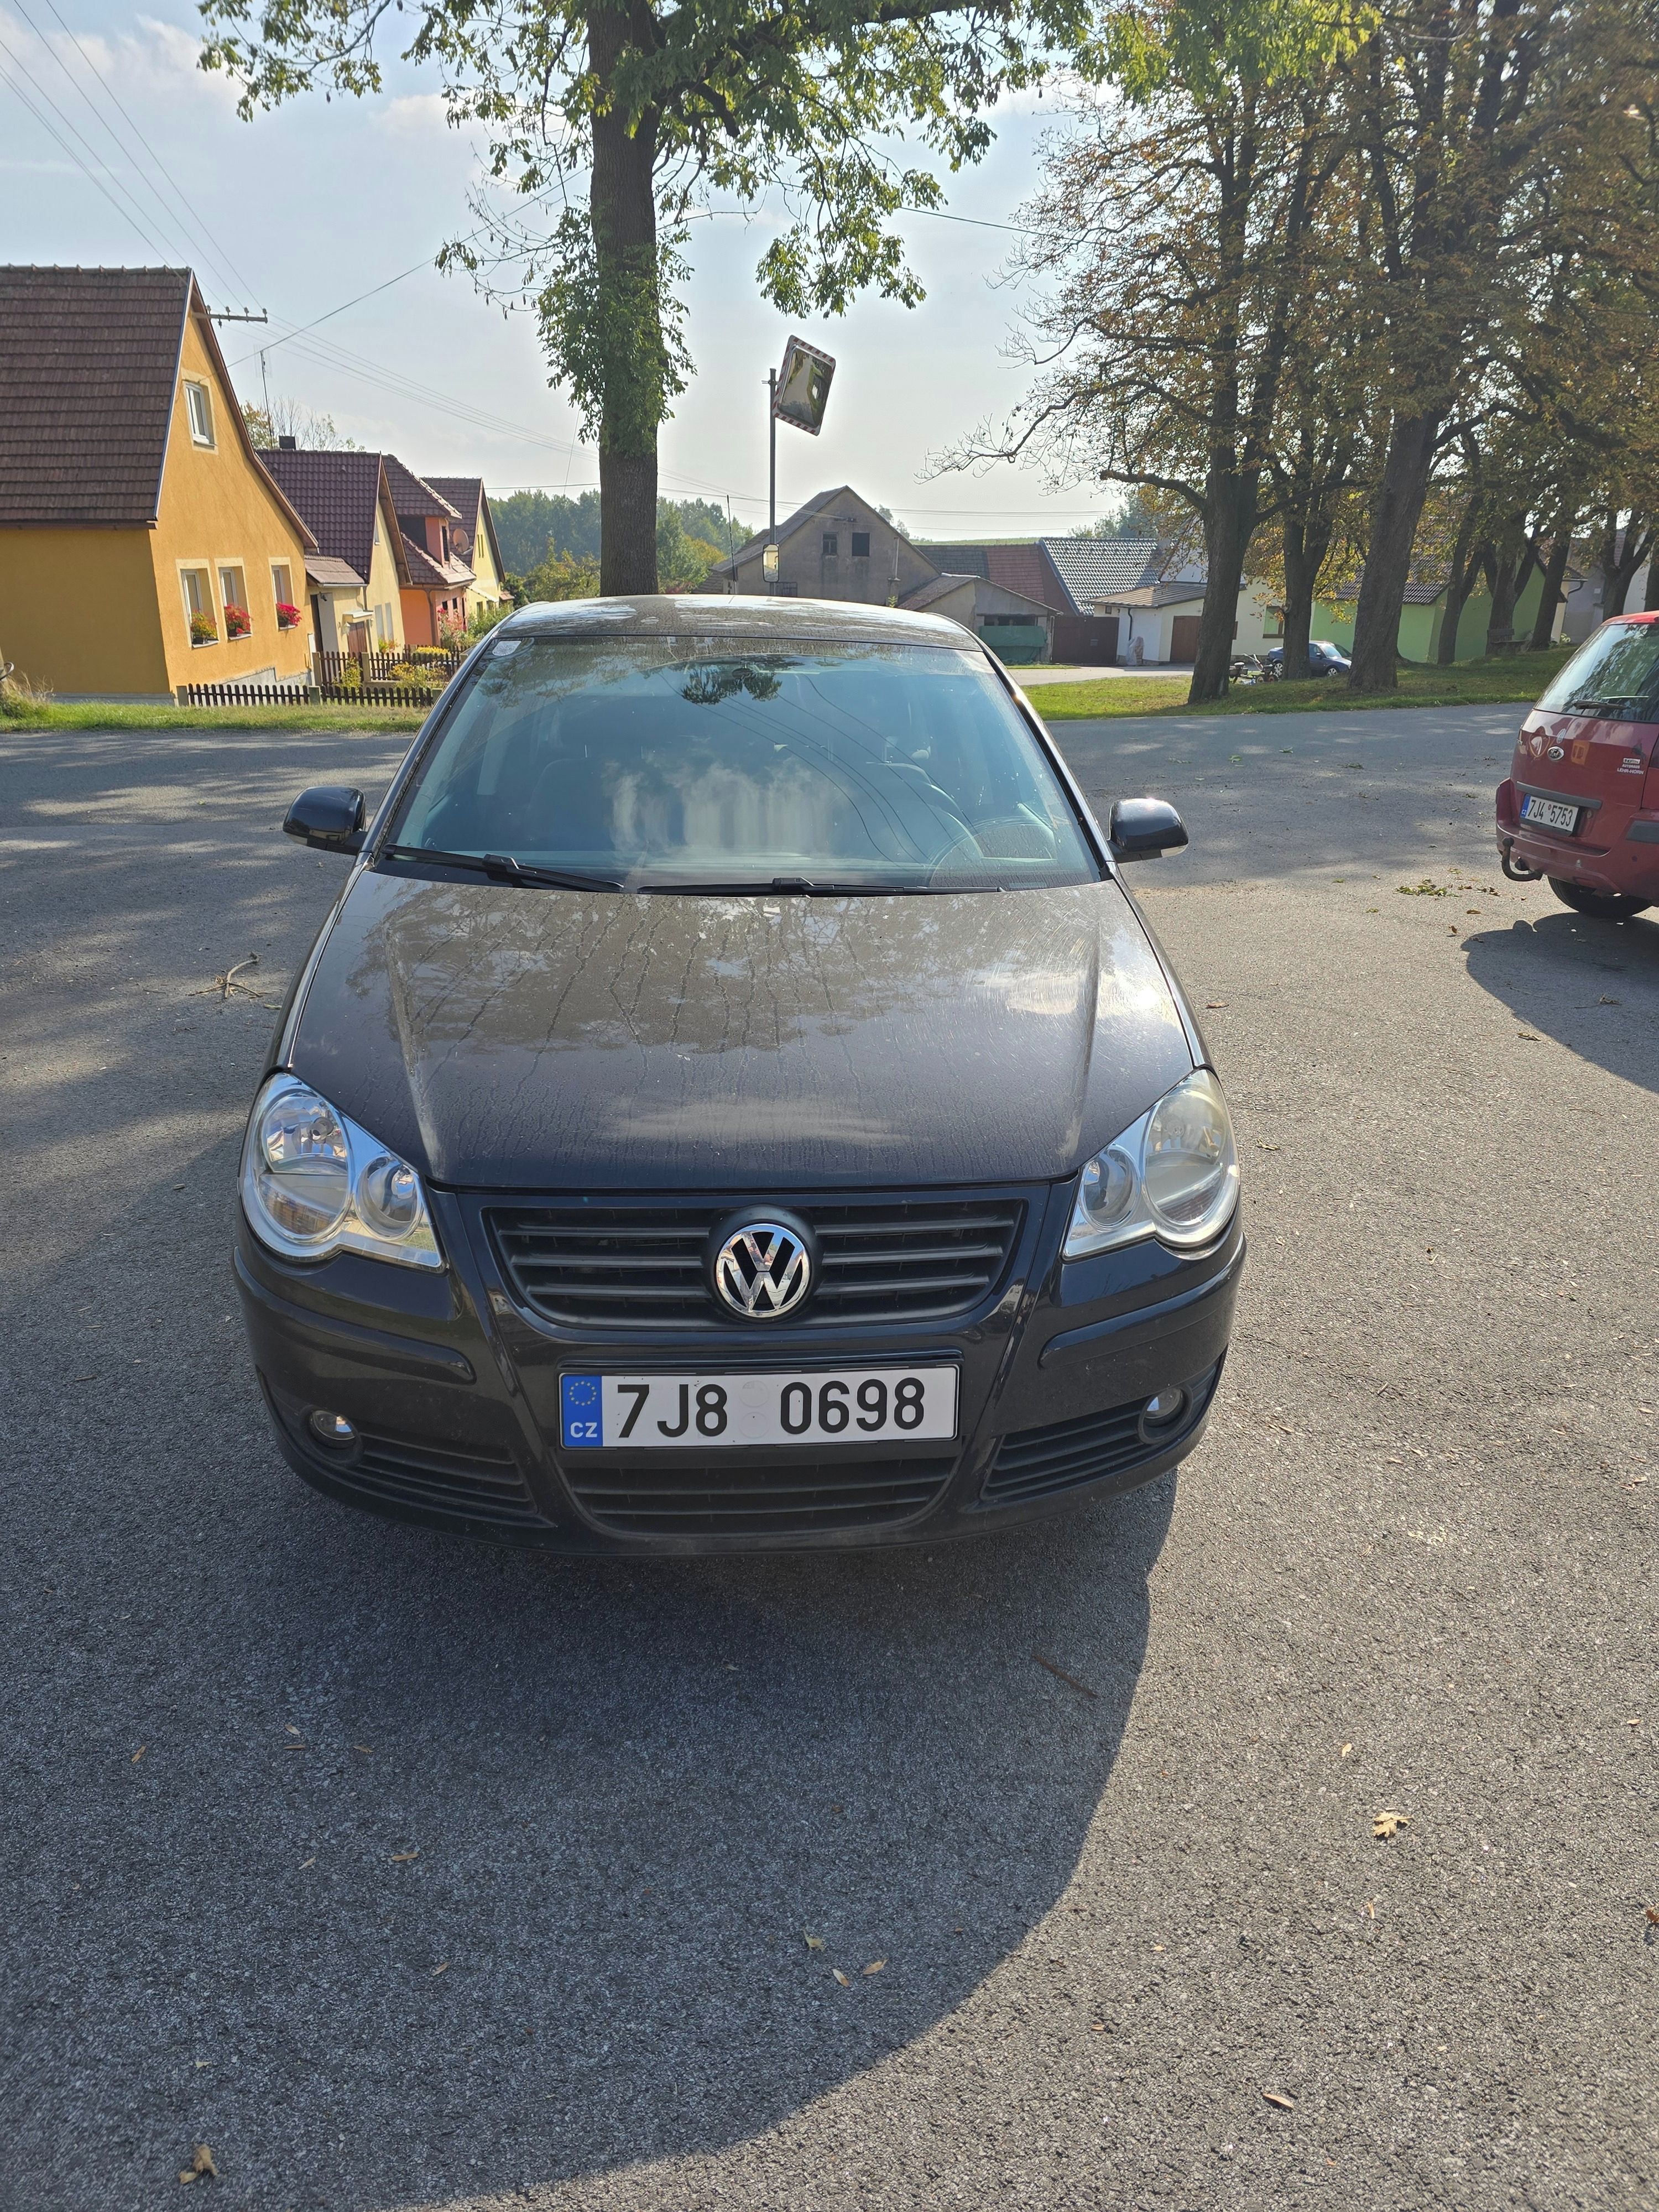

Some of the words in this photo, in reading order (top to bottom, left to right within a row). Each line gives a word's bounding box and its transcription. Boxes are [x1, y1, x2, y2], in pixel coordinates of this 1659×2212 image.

[1527, 799, 1545, 820] 7J4
[1550, 805, 1573, 827] 5753
[617, 1384, 727, 1438] 7J8
[780, 1378, 924, 1434] 0698
[571, 1422, 597, 1438] CZ
